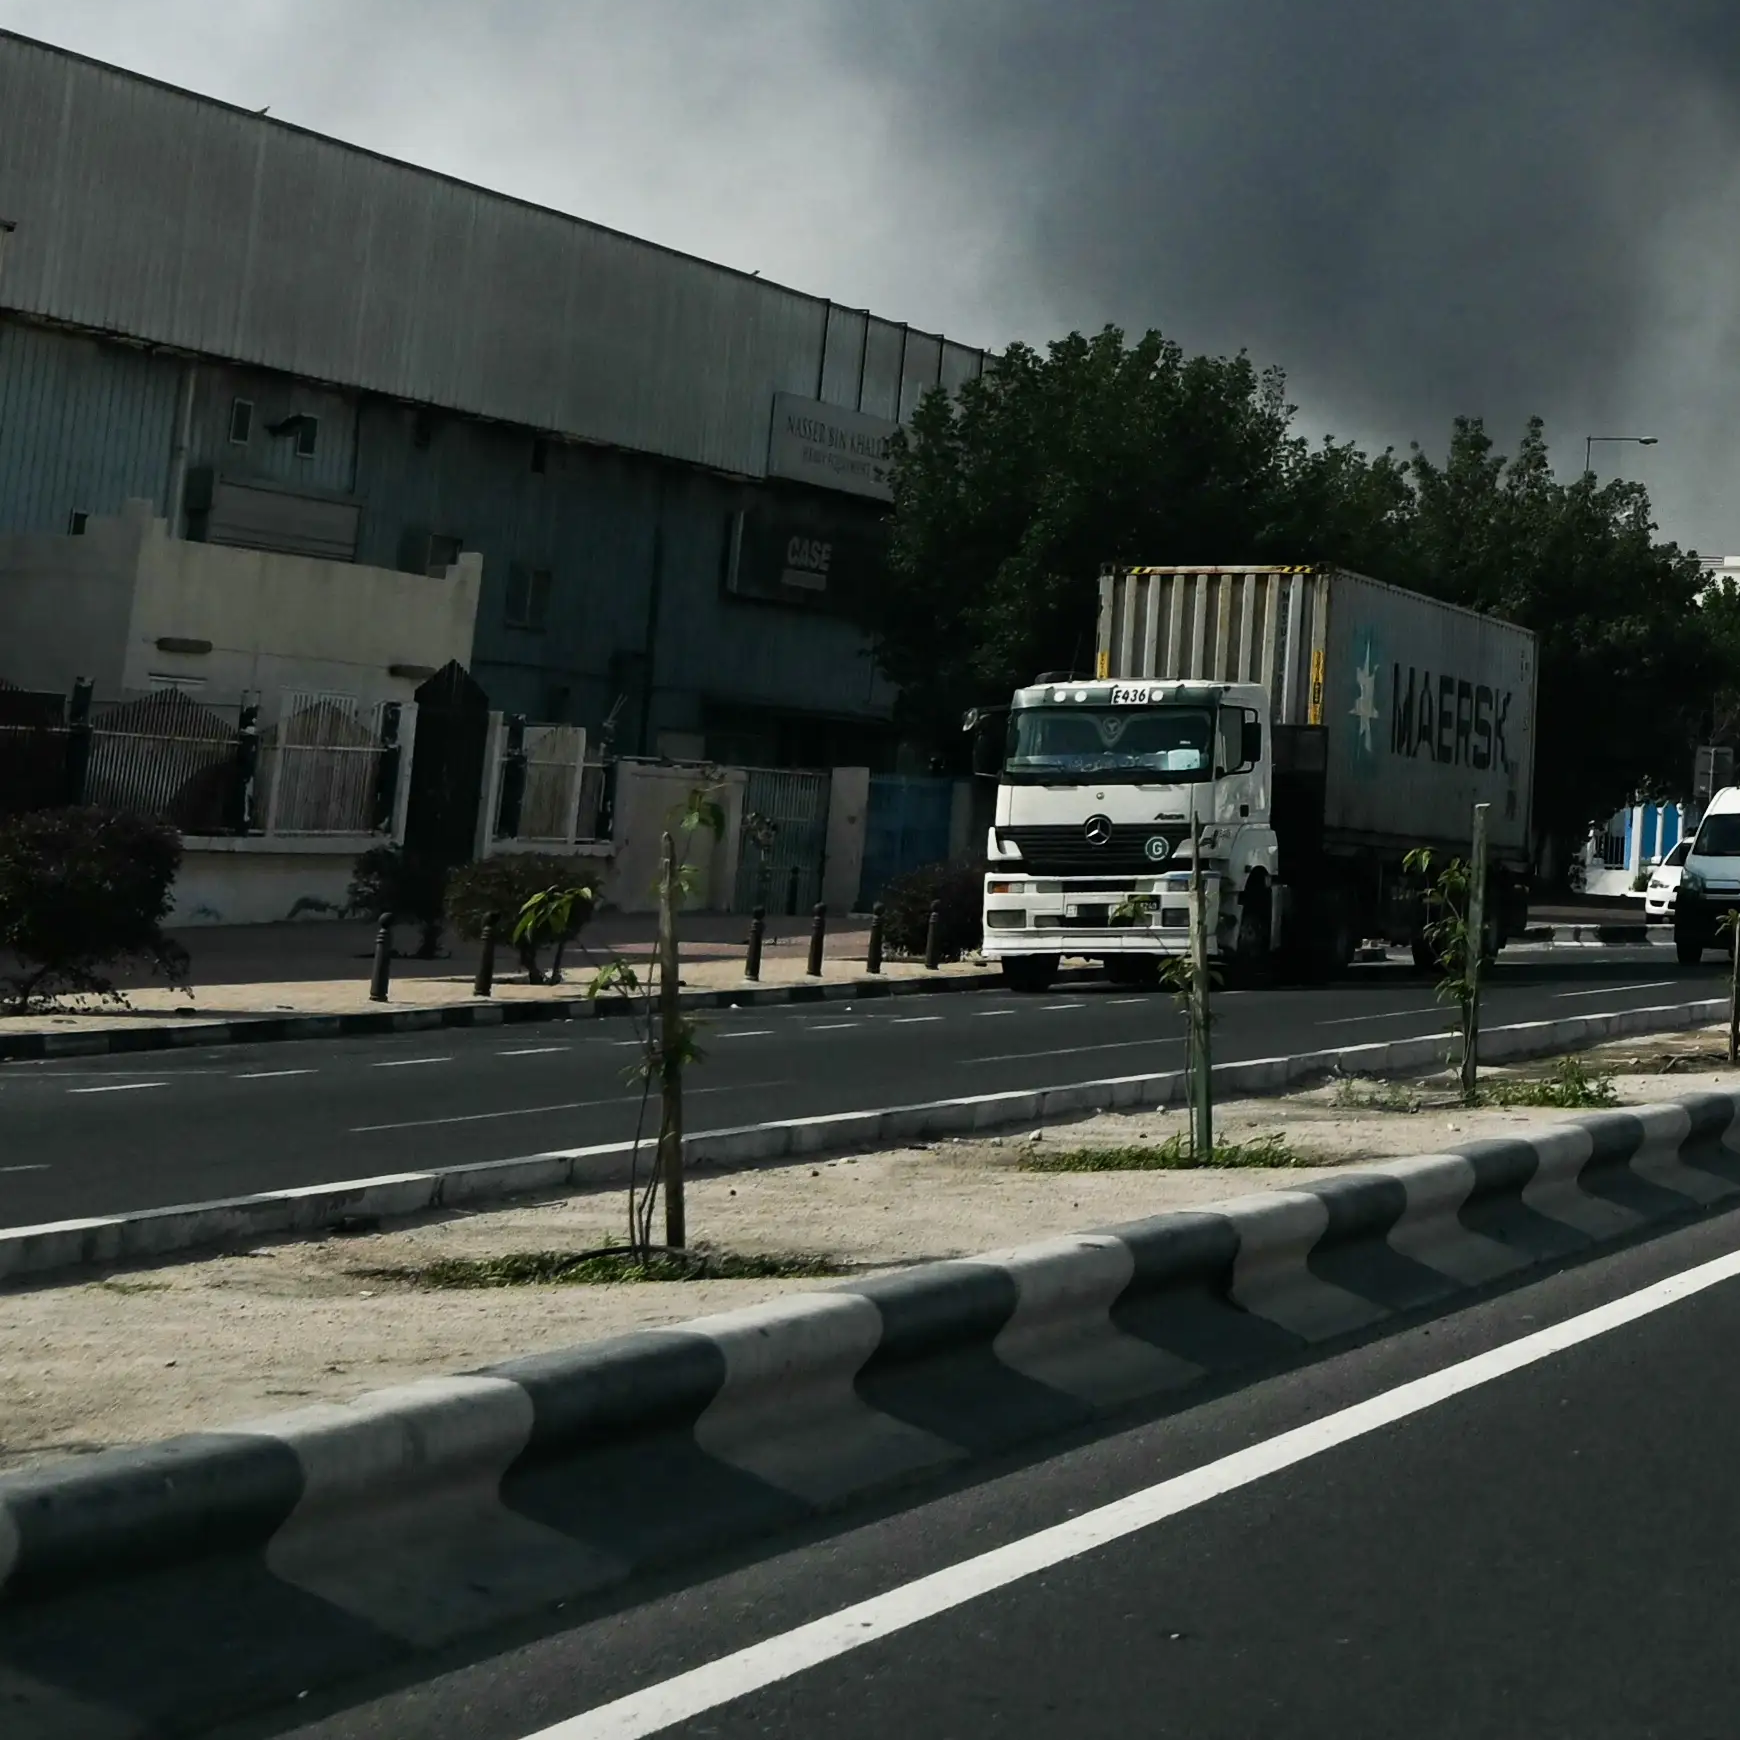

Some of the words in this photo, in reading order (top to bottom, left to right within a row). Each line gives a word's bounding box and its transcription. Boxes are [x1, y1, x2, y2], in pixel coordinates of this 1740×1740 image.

[787, 415, 825, 444] NASSER
[827, 426, 846, 449] BIN
[787, 535, 832, 572] CASE
[1113, 688, 1146, 703] E436
[1389, 661, 1511, 774] MAERSK
[1152, 841, 1163, 856] G
